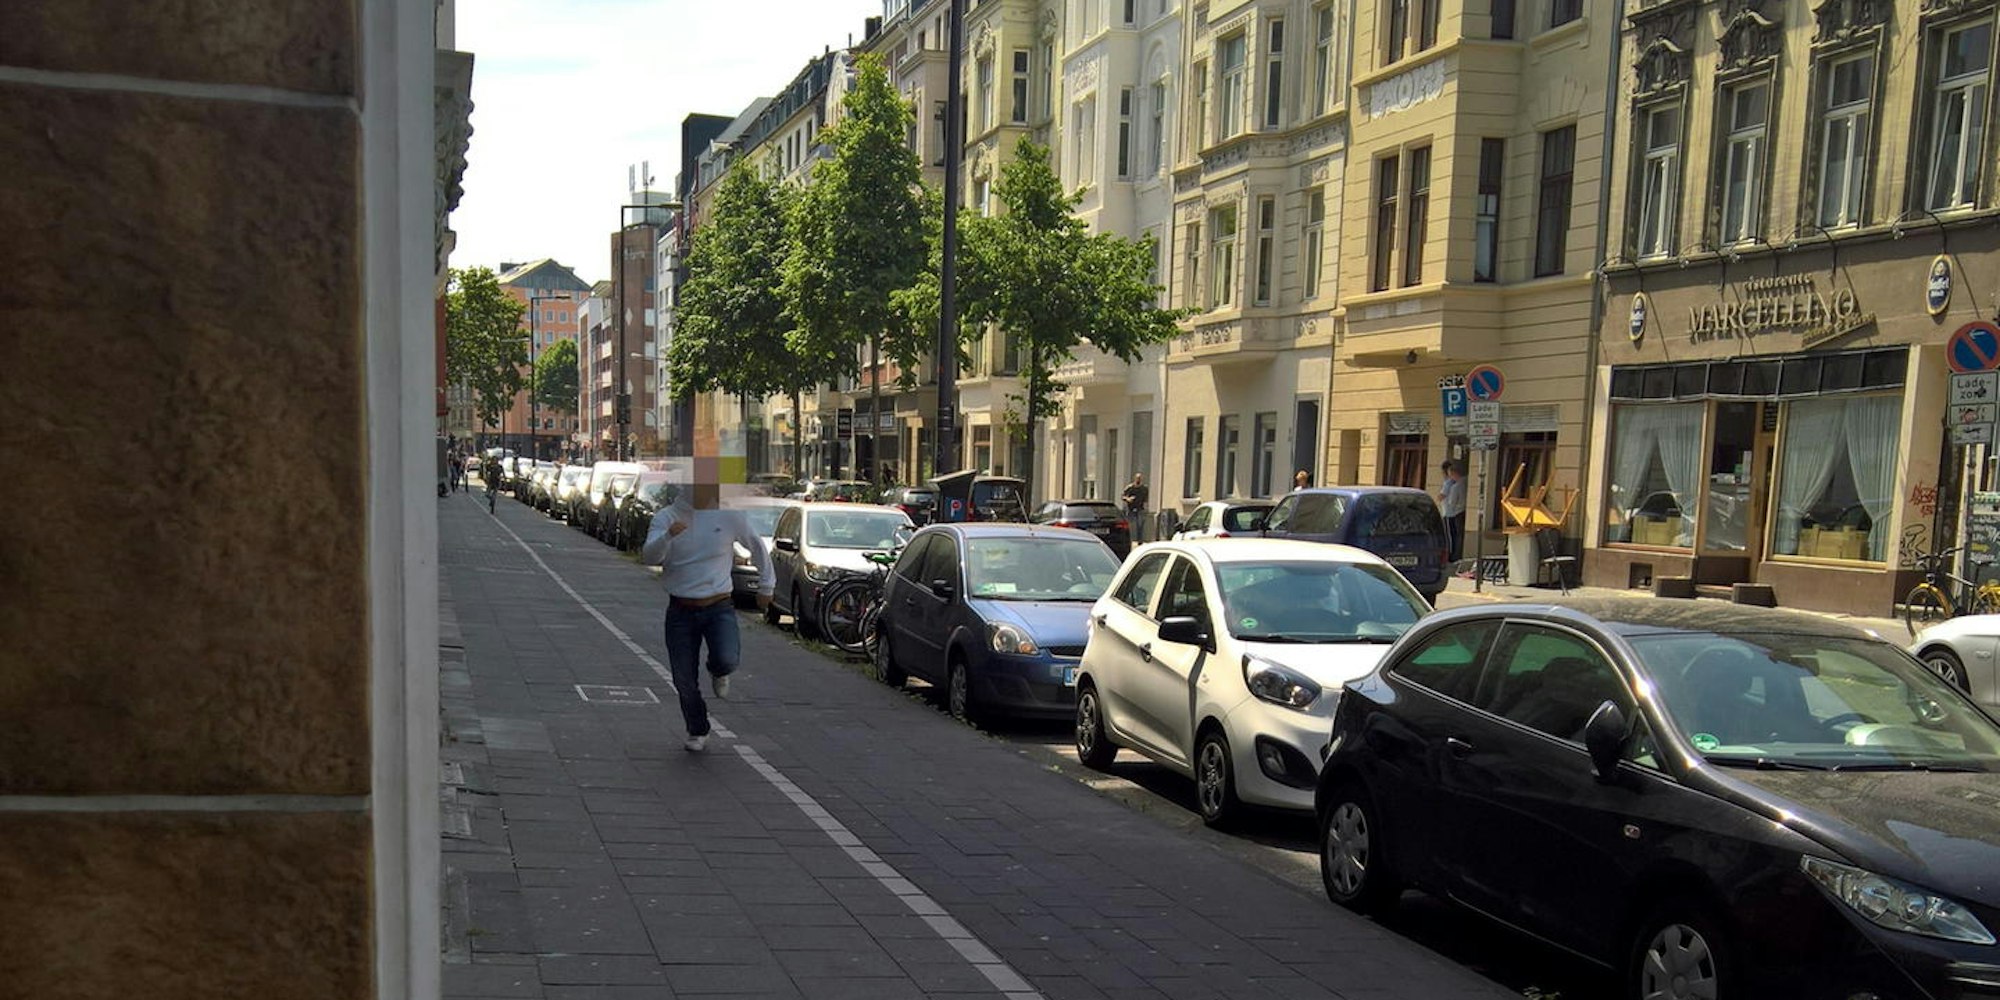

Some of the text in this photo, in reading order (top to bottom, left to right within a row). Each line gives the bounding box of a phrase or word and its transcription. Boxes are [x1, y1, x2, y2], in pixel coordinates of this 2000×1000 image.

[1743, 273, 1813, 292] ristorante
[1689, 288, 1854, 333] MARCELLINO
[1447, 390, 1462, 413] P
